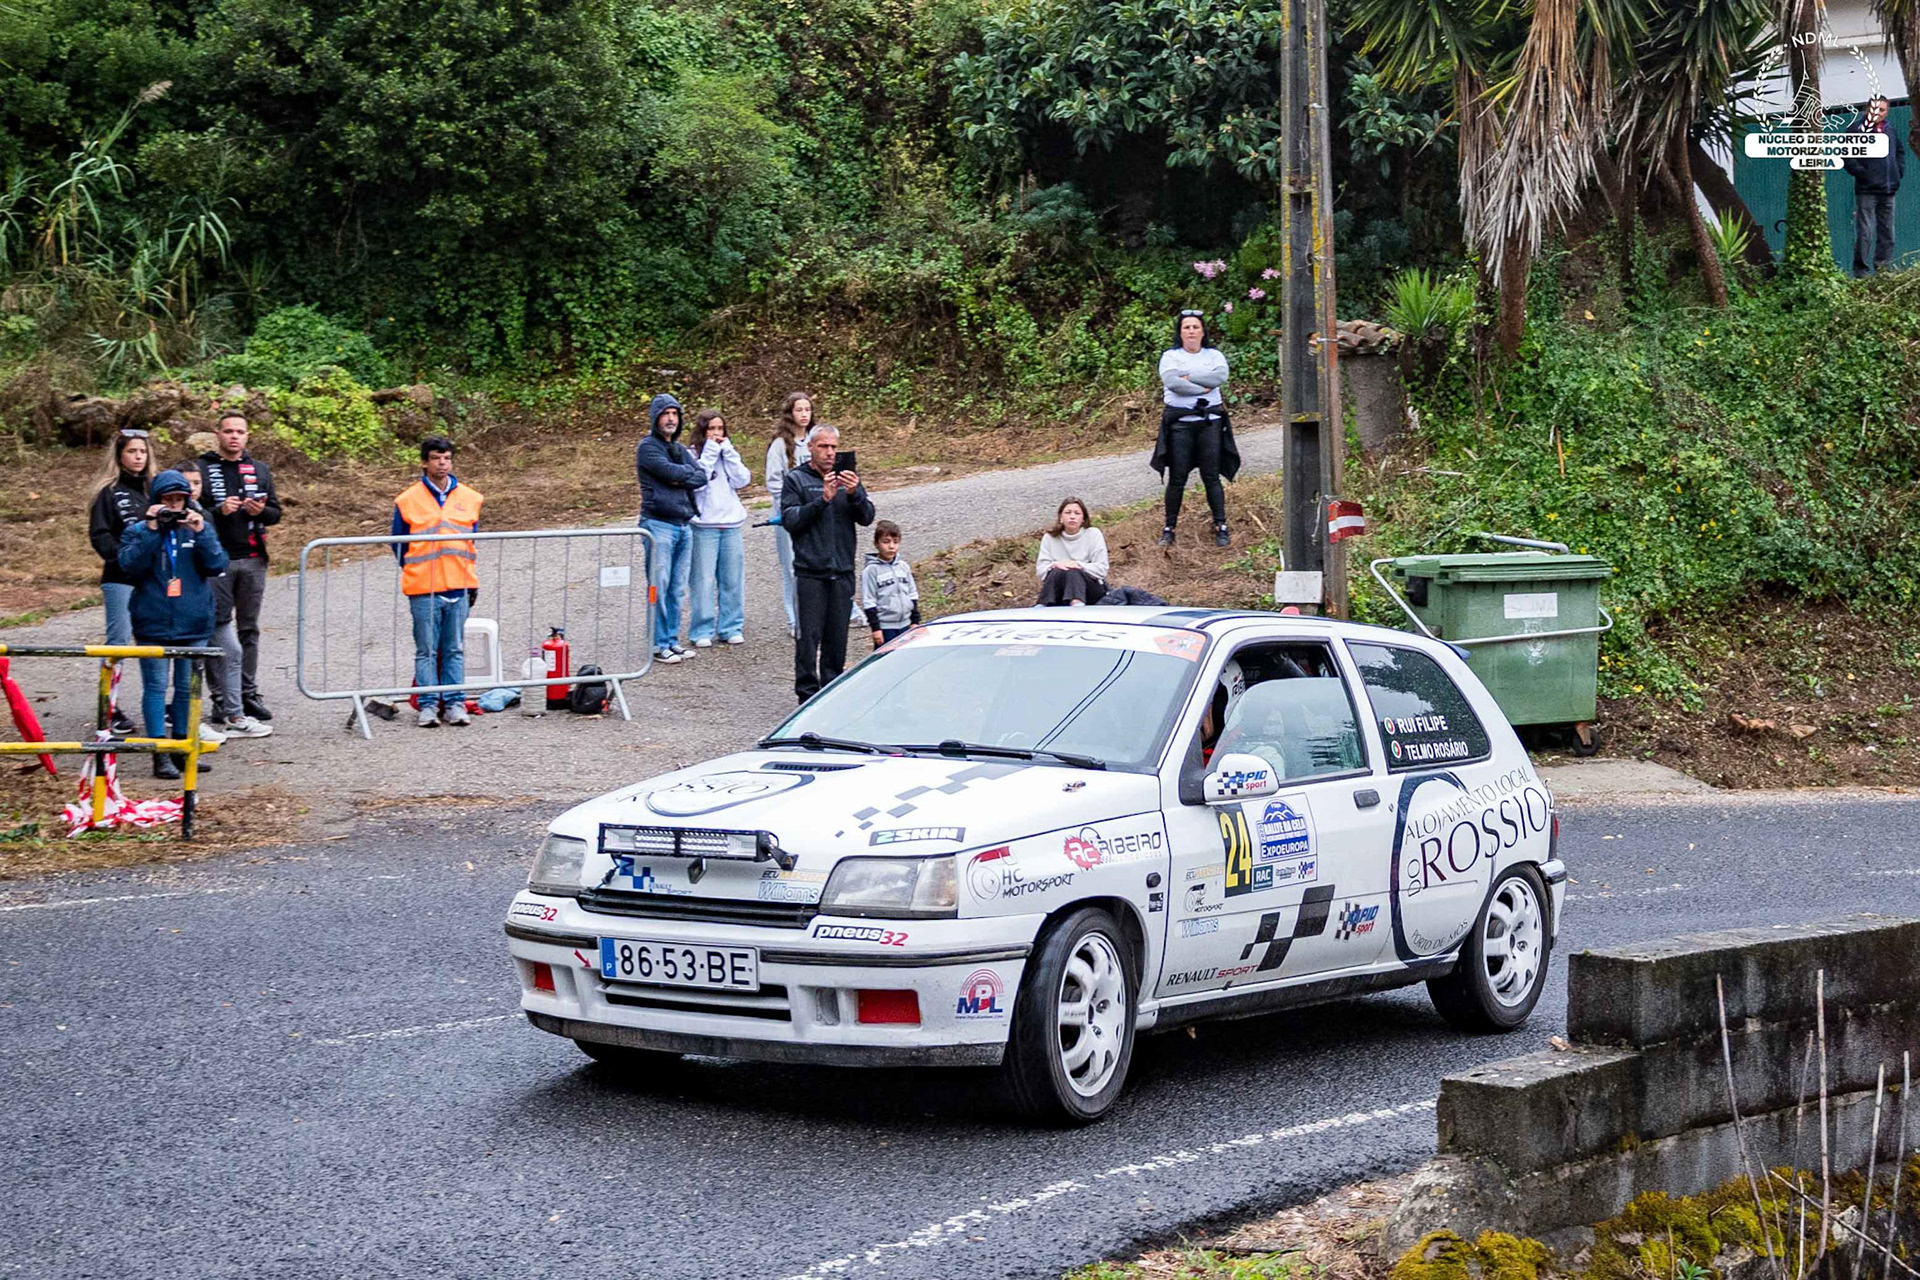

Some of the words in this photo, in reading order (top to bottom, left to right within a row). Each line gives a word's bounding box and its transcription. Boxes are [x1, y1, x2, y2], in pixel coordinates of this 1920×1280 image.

[1397, 716, 1417, 734] RUI
[1415, 715, 1448, 732] FILIPE
[1404, 743, 1434, 760] TELMO
[1432, 738, 1469, 757] ROSÁRIO
[1245, 780, 1267, 790] sport
[1405, 784, 1497, 845] ALOJAMENTO
[1494, 765, 1531, 796] LOCAL
[1098, 832, 1162, 855] RIBEIRO
[1219, 811, 1252, 888] 24
[1407, 858, 1421, 897] DO
[1420, 787, 1547, 890] ROSSIO
[1002, 867, 1025, 885] HC
[1002, 873, 1075, 898] MOTORSPORT
[1255, 869, 1271, 882] RAC
[758, 881, 819, 902] Williams
[1356, 920, 1375, 935] sport
[1411, 928, 1433, 951] PORTO
[1432, 937, 1446, 950] DE
[606, 963, 612, 971] P
[1166, 967, 1219, 986] RENAULT
[1216, 964, 1258, 978] SPORT
